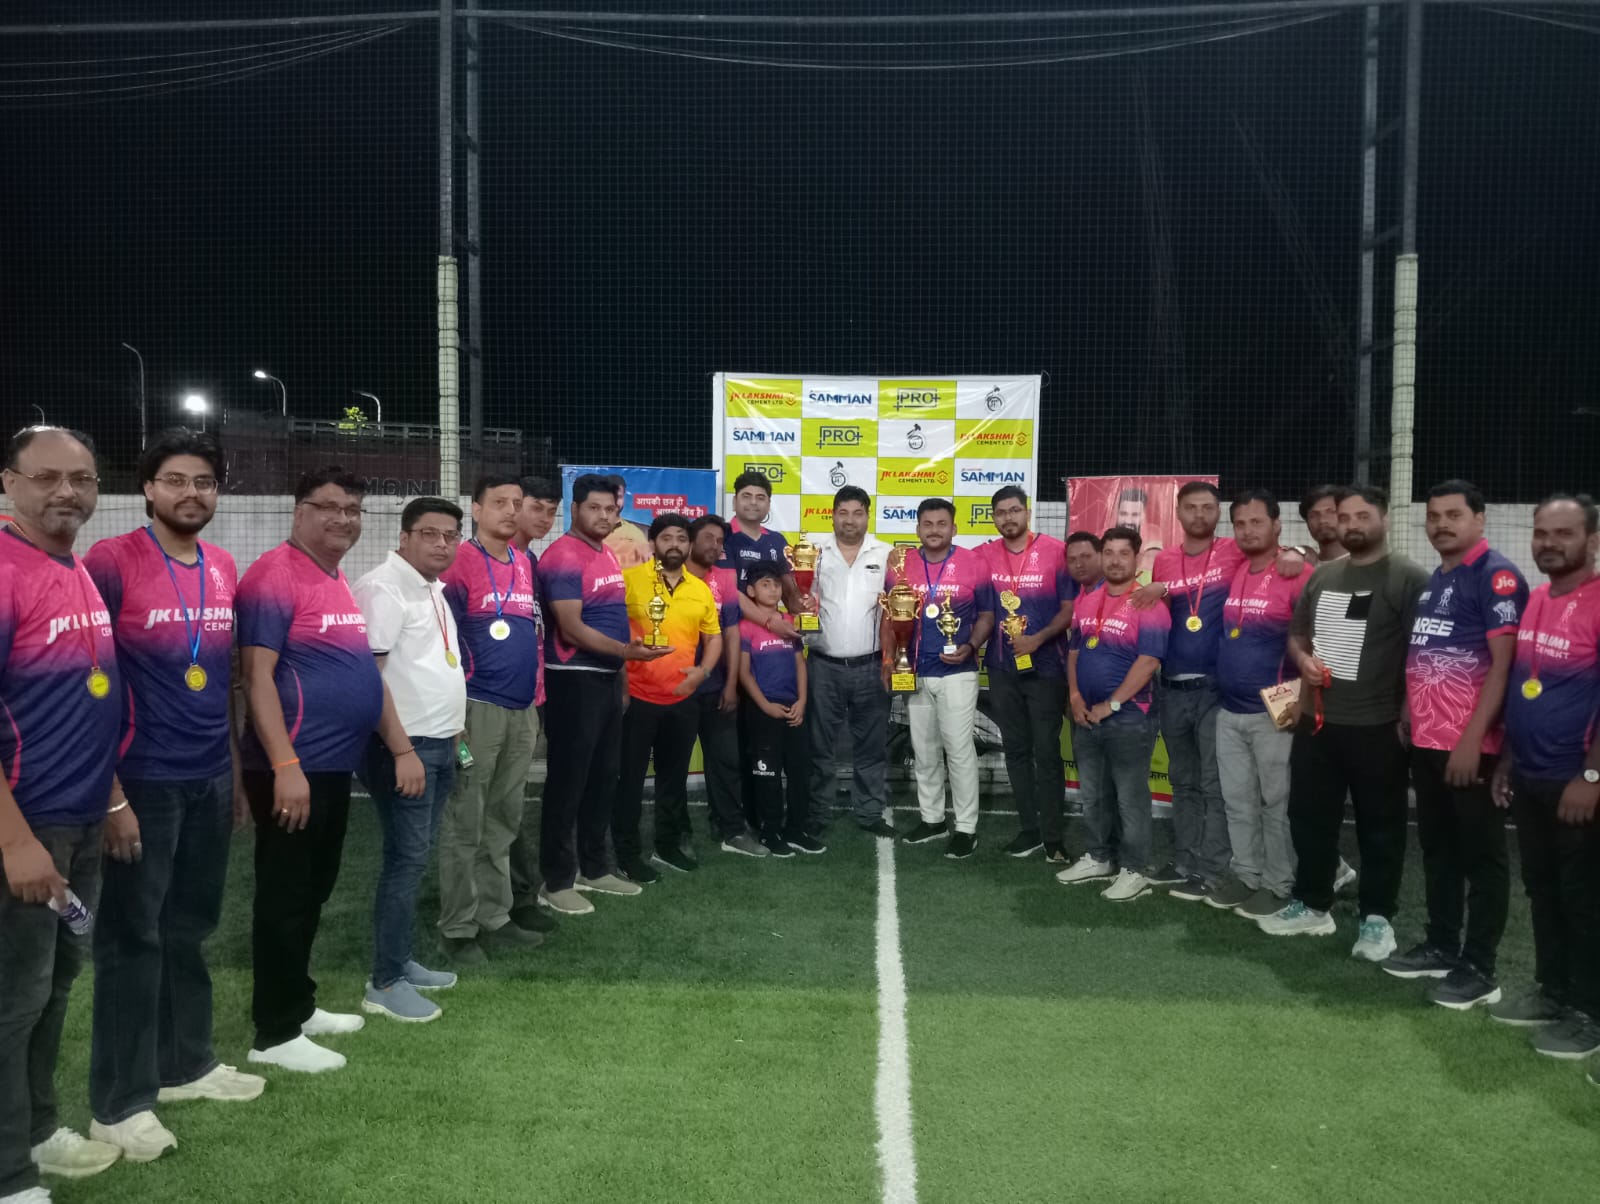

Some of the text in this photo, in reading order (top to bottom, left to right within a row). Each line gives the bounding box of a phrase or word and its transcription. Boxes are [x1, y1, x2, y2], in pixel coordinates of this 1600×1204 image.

[809, 393, 872, 405] SAMMAN
[881, 471, 936, 481] JK LAKSHMI
[961, 471, 1025, 482] SAMMAN
[804, 507, 815, 518] JK
[1496, 575, 1516, 590] Jio
[144, 609, 172, 630] JK
[319, 614, 337, 633] JK
[46, 615, 72, 645] JK
